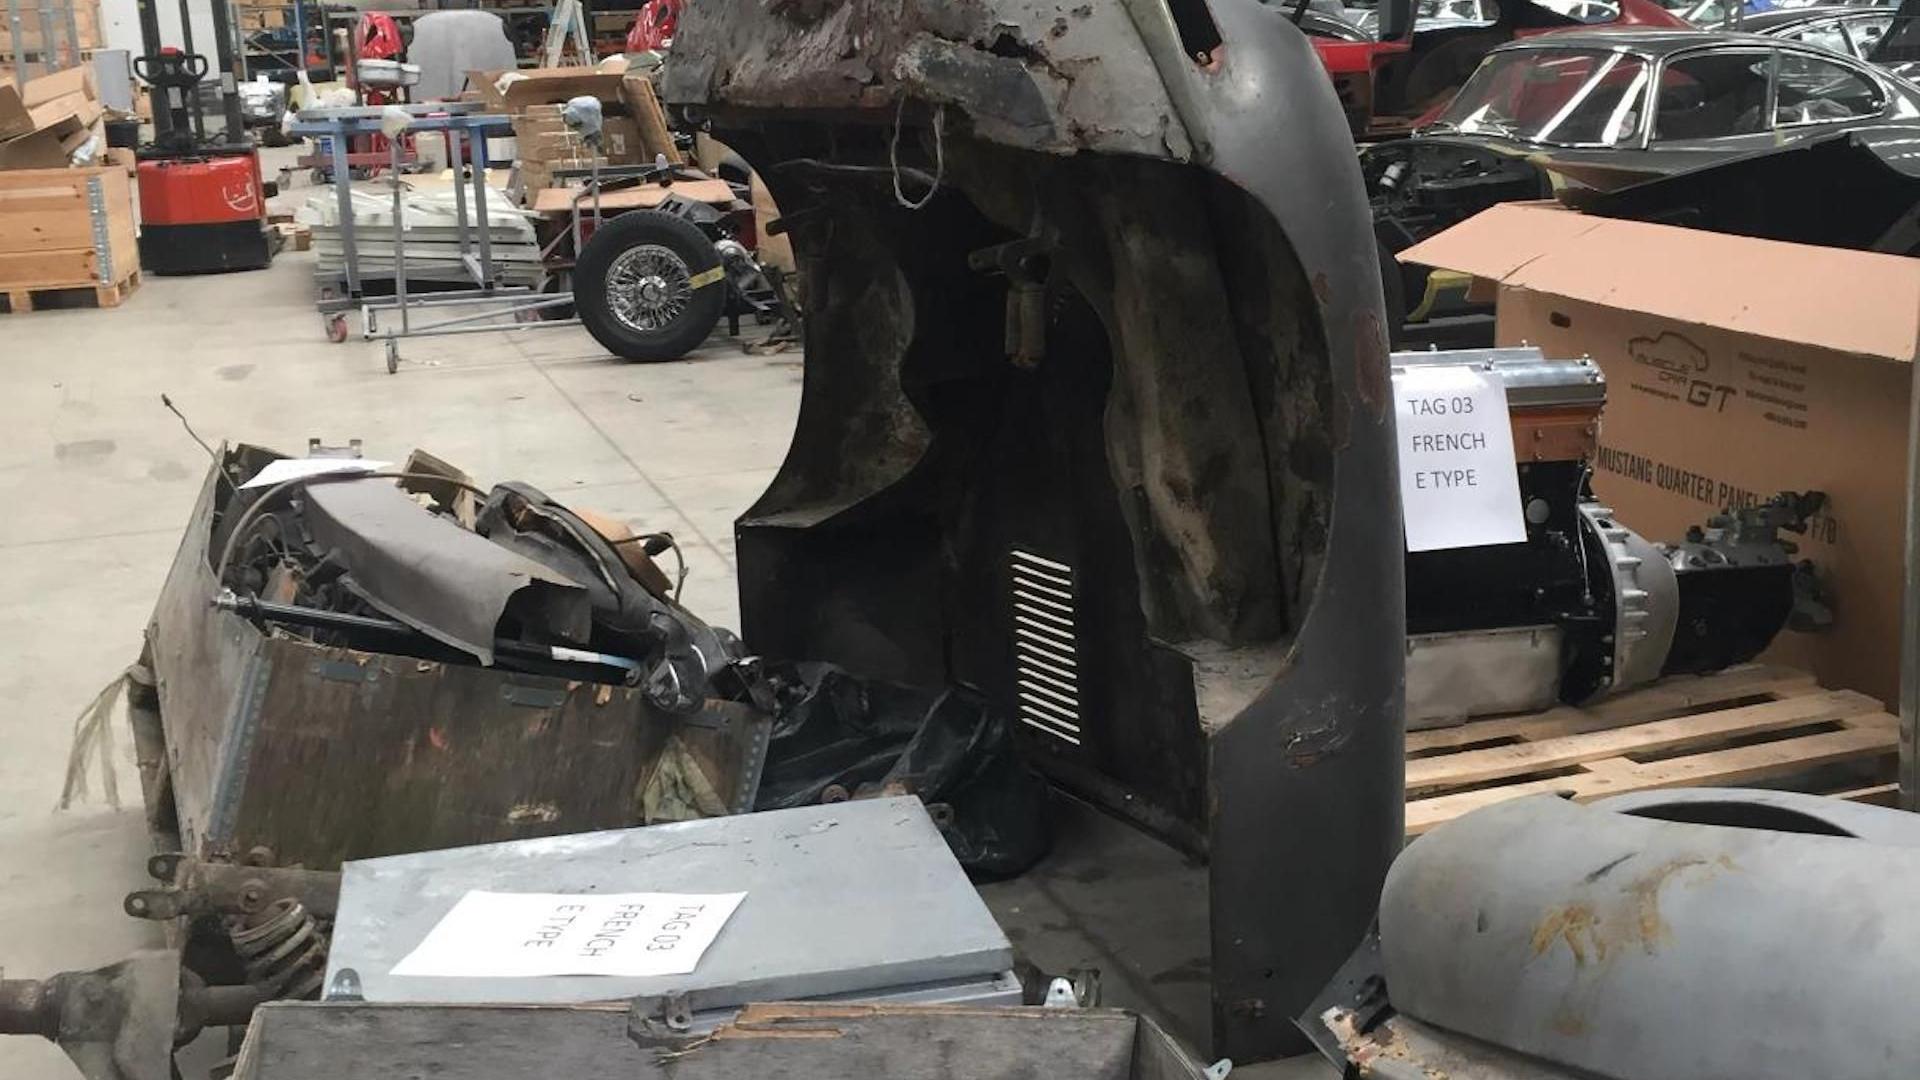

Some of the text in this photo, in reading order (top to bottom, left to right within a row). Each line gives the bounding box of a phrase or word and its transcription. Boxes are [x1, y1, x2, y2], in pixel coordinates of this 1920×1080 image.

[1635, 353, 1691, 374] MUSCLE
[1408, 397, 1474, 416] TAG 03
[1658, 371, 1687, 386] CAR
[1687, 380, 1737, 413] GT
[1412, 432, 1486, 453] FRENCH
[1416, 469, 1478, 489] E TYPE
[1597, 446, 1652, 484] MUSTANG
[1656, 464, 1714, 504] QUARTER
[524, 904, 586, 948] E TYPE
[580, 904, 645, 957] FRENCH
[646, 905, 706, 952] TAG 03
